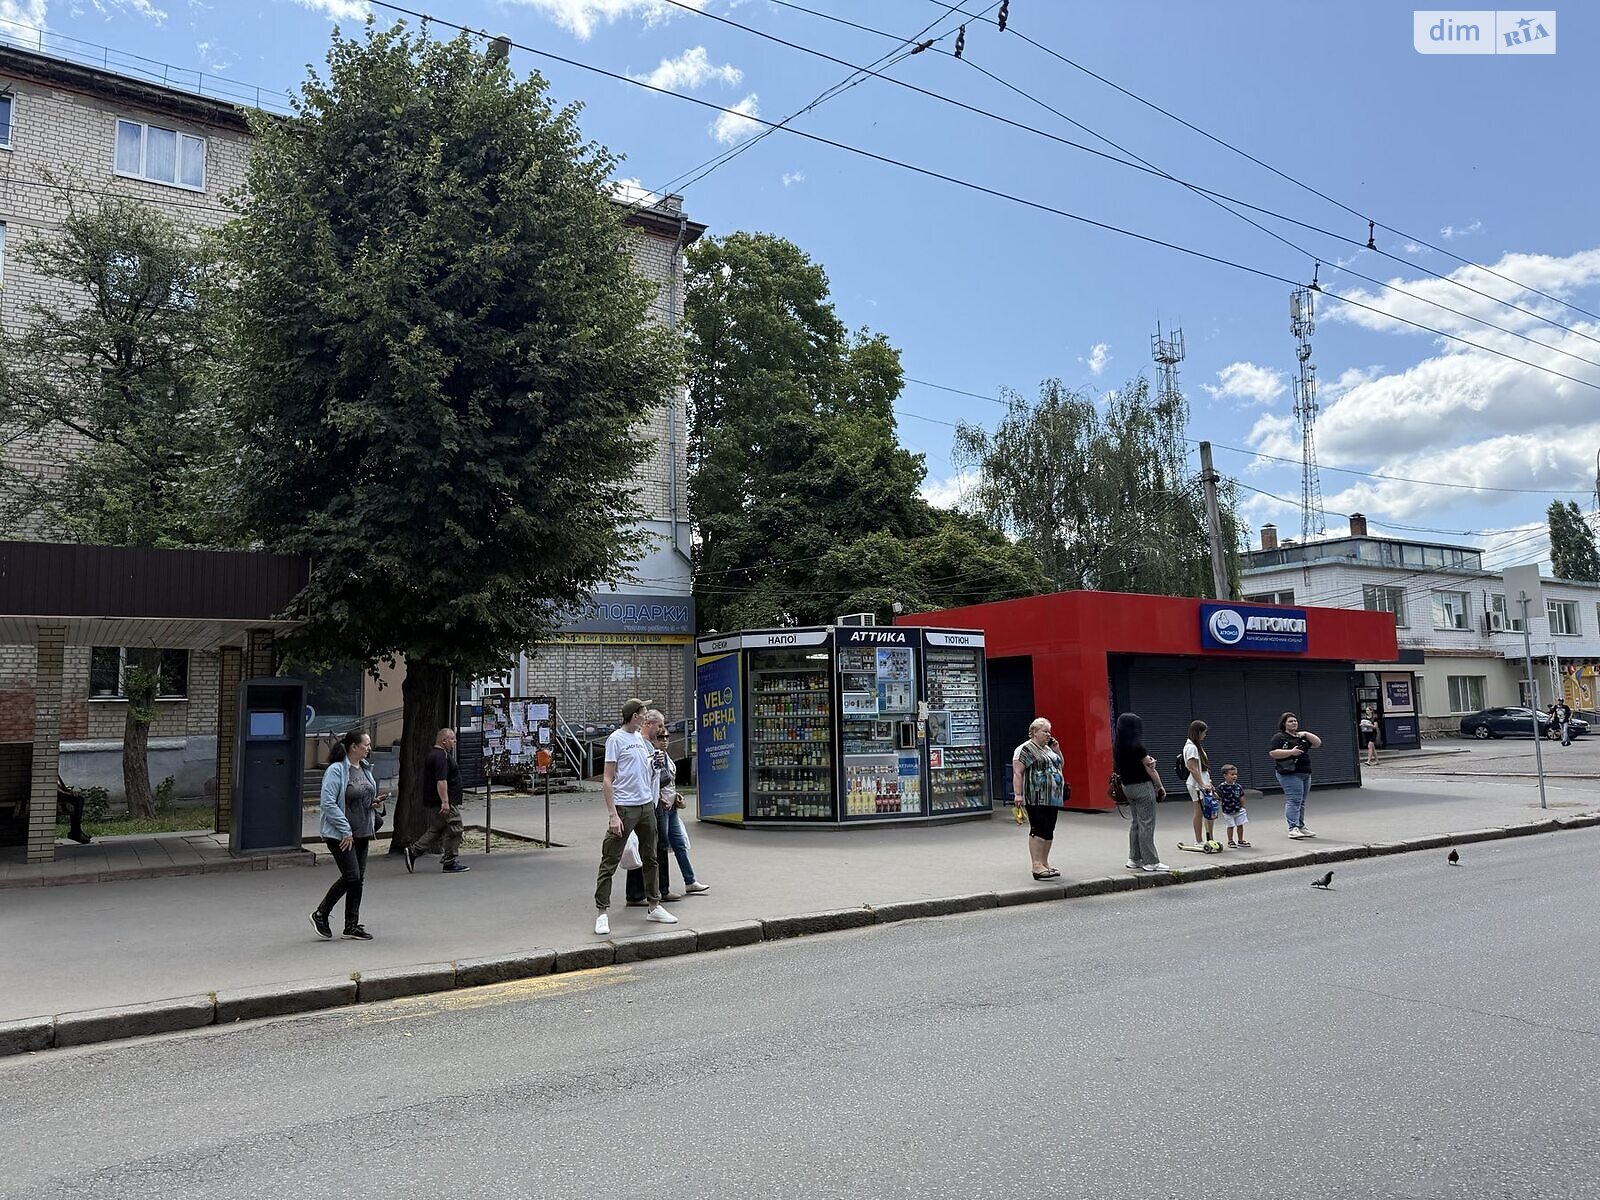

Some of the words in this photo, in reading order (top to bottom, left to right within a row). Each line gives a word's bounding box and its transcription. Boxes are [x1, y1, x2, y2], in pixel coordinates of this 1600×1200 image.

[768, 634, 797, 645] НАПОЇ
[850, 631, 906, 643] АТТИКА
[944, 635, 970, 645] ТЮТЮН
[703, 686, 733, 709] VELO
[702, 706, 736, 728] БРЕНД
[712, 725, 727, 741] №1
